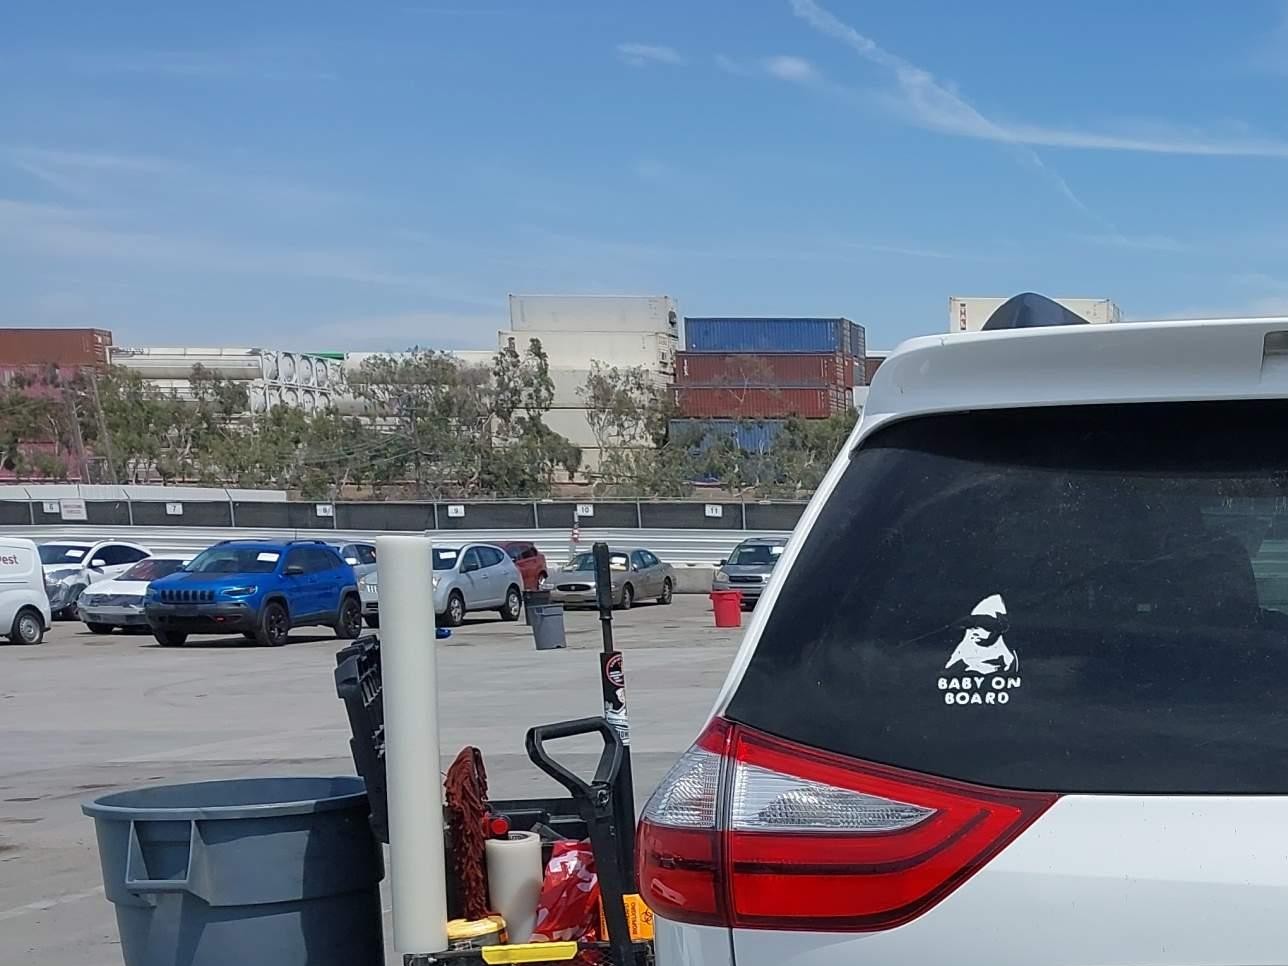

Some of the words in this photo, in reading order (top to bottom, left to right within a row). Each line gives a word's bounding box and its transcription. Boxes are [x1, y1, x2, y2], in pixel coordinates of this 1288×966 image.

[581, 506, 590, 514] 10
[710, 506, 719, 515] 11
[0, 555, 19, 565] est
[938, 677, 985, 690] BABY
[991, 676, 1021, 690] ON
[944, 691, 1010, 705] BOARD
